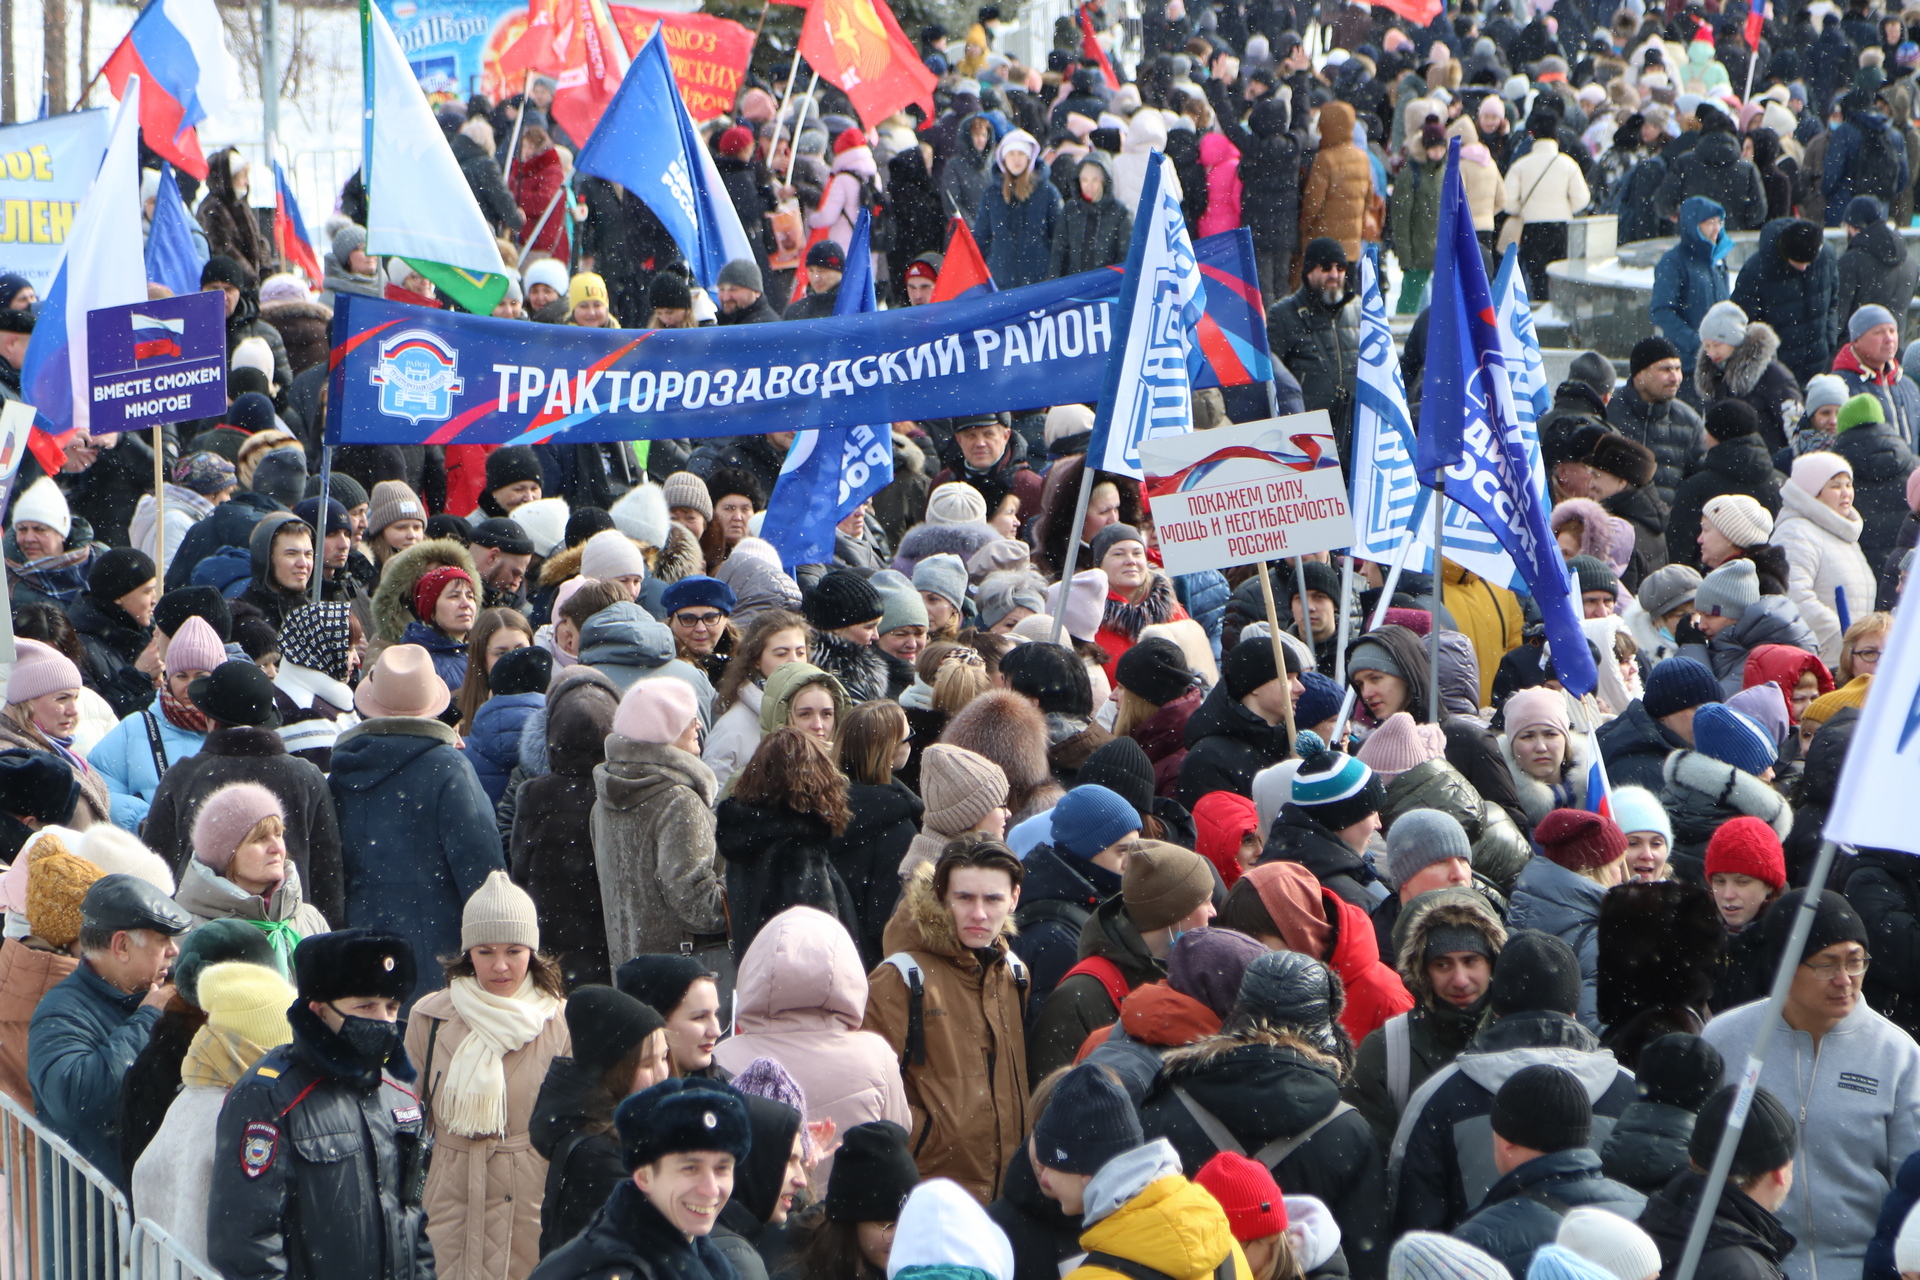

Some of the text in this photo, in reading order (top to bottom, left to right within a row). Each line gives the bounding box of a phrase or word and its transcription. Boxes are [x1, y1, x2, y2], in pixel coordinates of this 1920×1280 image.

[0, 144, 54, 182] ОЕ
[0, 199, 81, 244] ЛЕН
[492, 301, 1112, 414] ТРАКТОРОЗАВОДСКИЙ РАЙОН
[94, 366, 221, 402] ВМЕСТЕ СМОЖЕМ
[125, 394, 192, 419] МНОГОЕ!
[1187, 479, 1308, 516] ПОКАЖЕМ СИЛУ,
[1160, 497, 1345, 545] МОЩЬ И НЕСГИБАЕМОСТЬ
[1228, 530, 1288, 557] РОССИИ!
